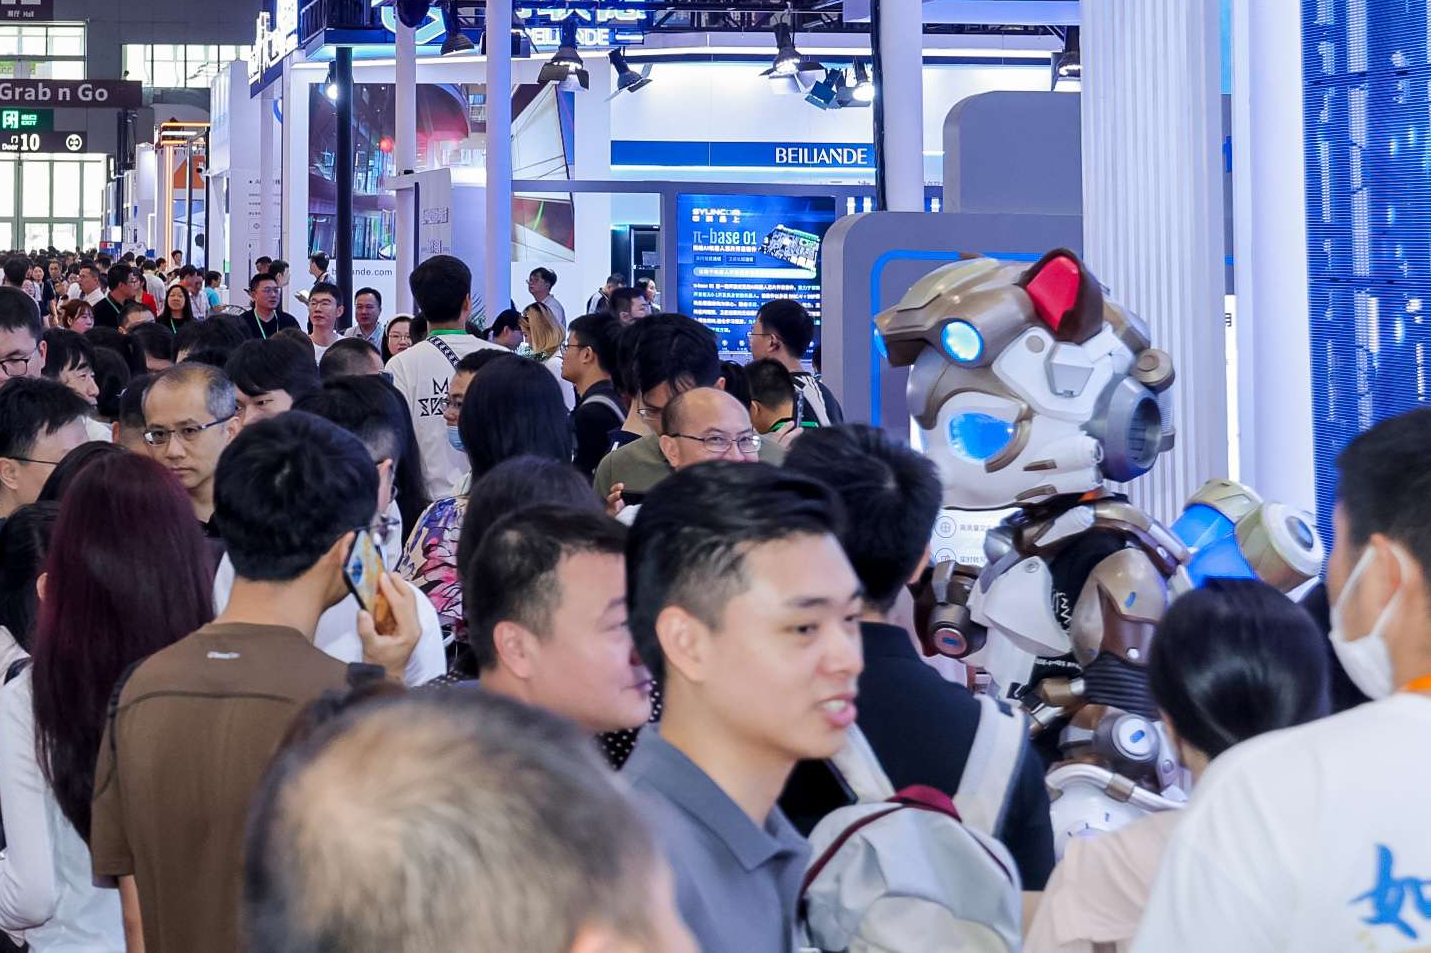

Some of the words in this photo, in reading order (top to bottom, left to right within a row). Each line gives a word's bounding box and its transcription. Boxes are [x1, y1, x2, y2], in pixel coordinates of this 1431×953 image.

[58, 86, 70, 100] n
[77, 83, 109, 102] Go
[2, 143, 18, 151] Door
[20, 133, 40, 151] 10
[775, 147, 868, 165] BEILIANDE
[743, 231, 757, 245] 01
